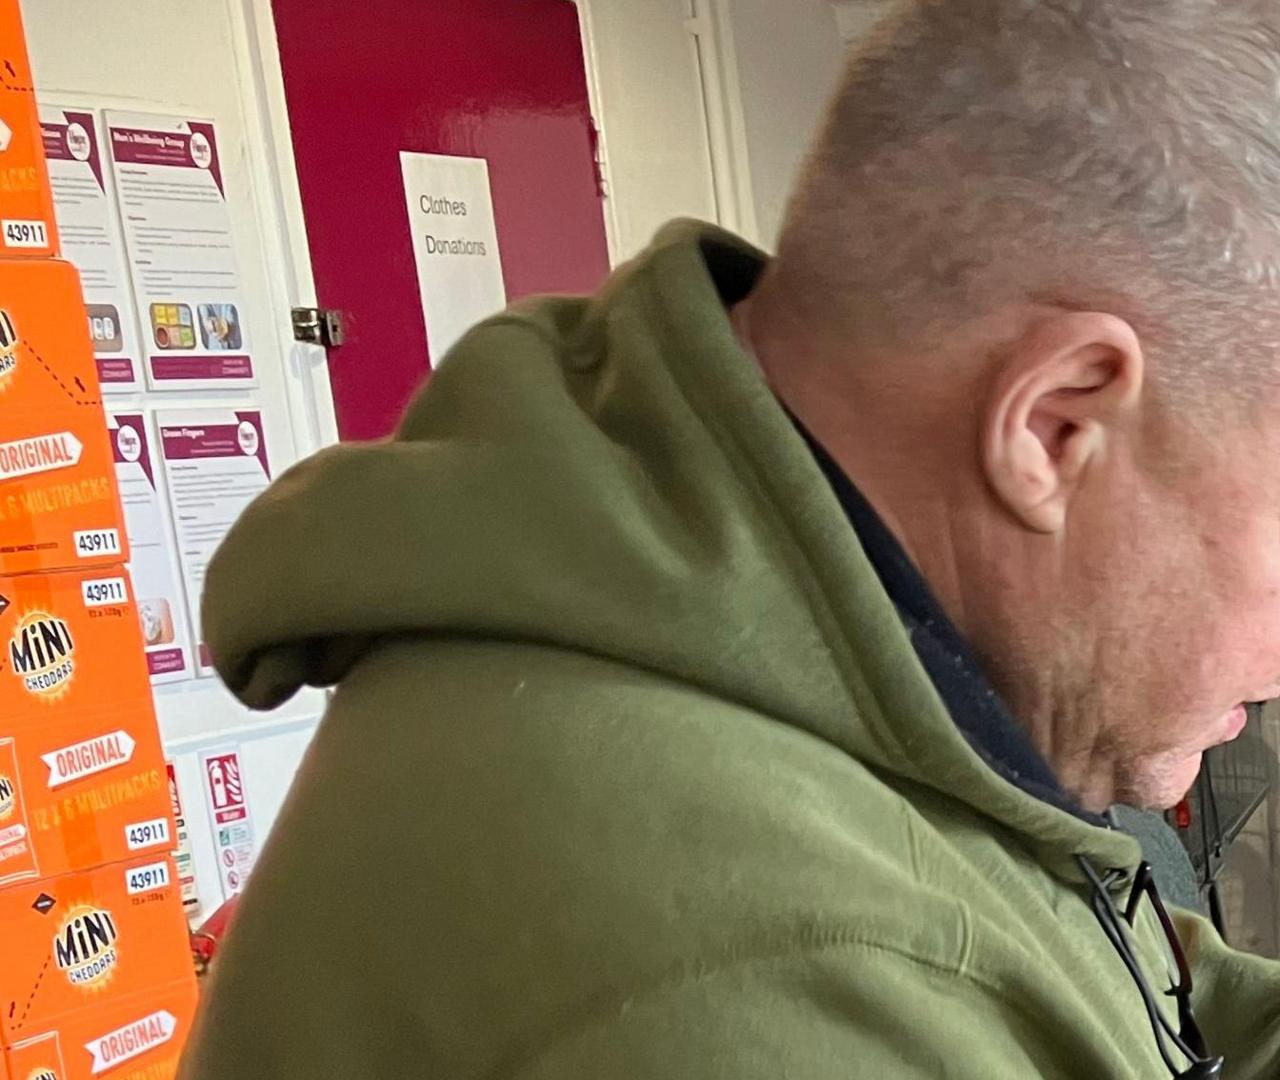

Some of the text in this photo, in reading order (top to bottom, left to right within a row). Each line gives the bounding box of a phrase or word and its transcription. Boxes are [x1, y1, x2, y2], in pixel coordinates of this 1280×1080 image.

[165, 137, 185, 149] Group
[420, 194, 467, 216] Clothes
[7, 224, 44, 242] 43911
[425, 235, 487, 256] Donations
[0, 436, 73, 474] ORIGINAL
[78, 532, 117, 552] 43911
[86, 583, 124, 602] 43911
[26, 661, 72, 690] CHEDDARS
[56, 736, 126, 778] ORIGINAL
[130, 823, 164, 843] 43911
[130, 868, 165, 889] 43911
[70, 950, 116, 983] CHEDDARS
[100, 1016, 167, 1063] ORIGINAL
